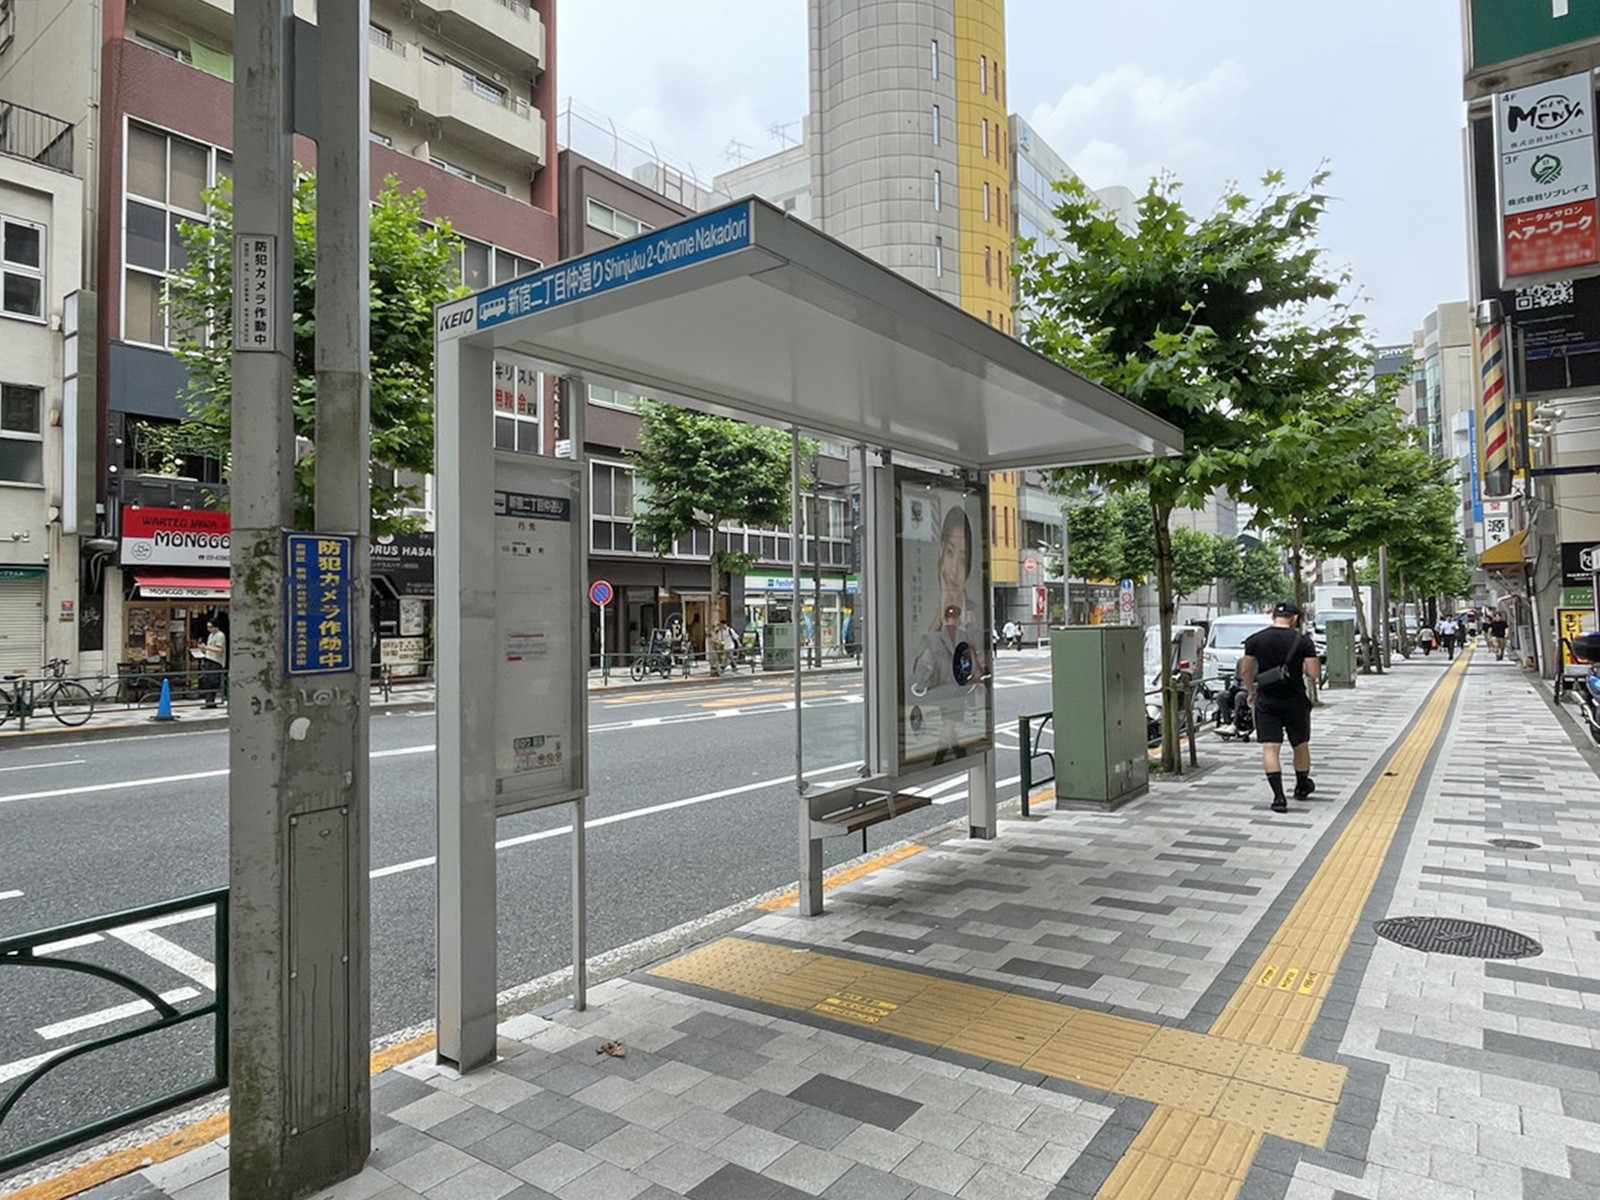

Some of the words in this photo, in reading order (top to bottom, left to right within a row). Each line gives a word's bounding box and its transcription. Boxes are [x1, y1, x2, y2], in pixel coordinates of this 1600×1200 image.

[1502, 93, 1517, 102] 4F
[1504, 155, 1520, 165] 3F
[1516, 206, 1583, 225] トータルサロン
[1507, 215, 1593, 241] ヘアーワーク
[507, 259, 604, 316] 新宿二丁目仲通り
[604, 250, 646, 283] Shinjuku
[647, 236, 695, 268] 2-Chome
[695, 211, 748, 252] Nakadori
[253, 240, 268, 346] 防犯カメラ作動中
[439, 307, 474, 332] KEIO
[153, 530, 230, 550] MONGGO
[401, 546, 435, 557] HASA
[318, 539, 343, 668] 防犯カメラ作動中
